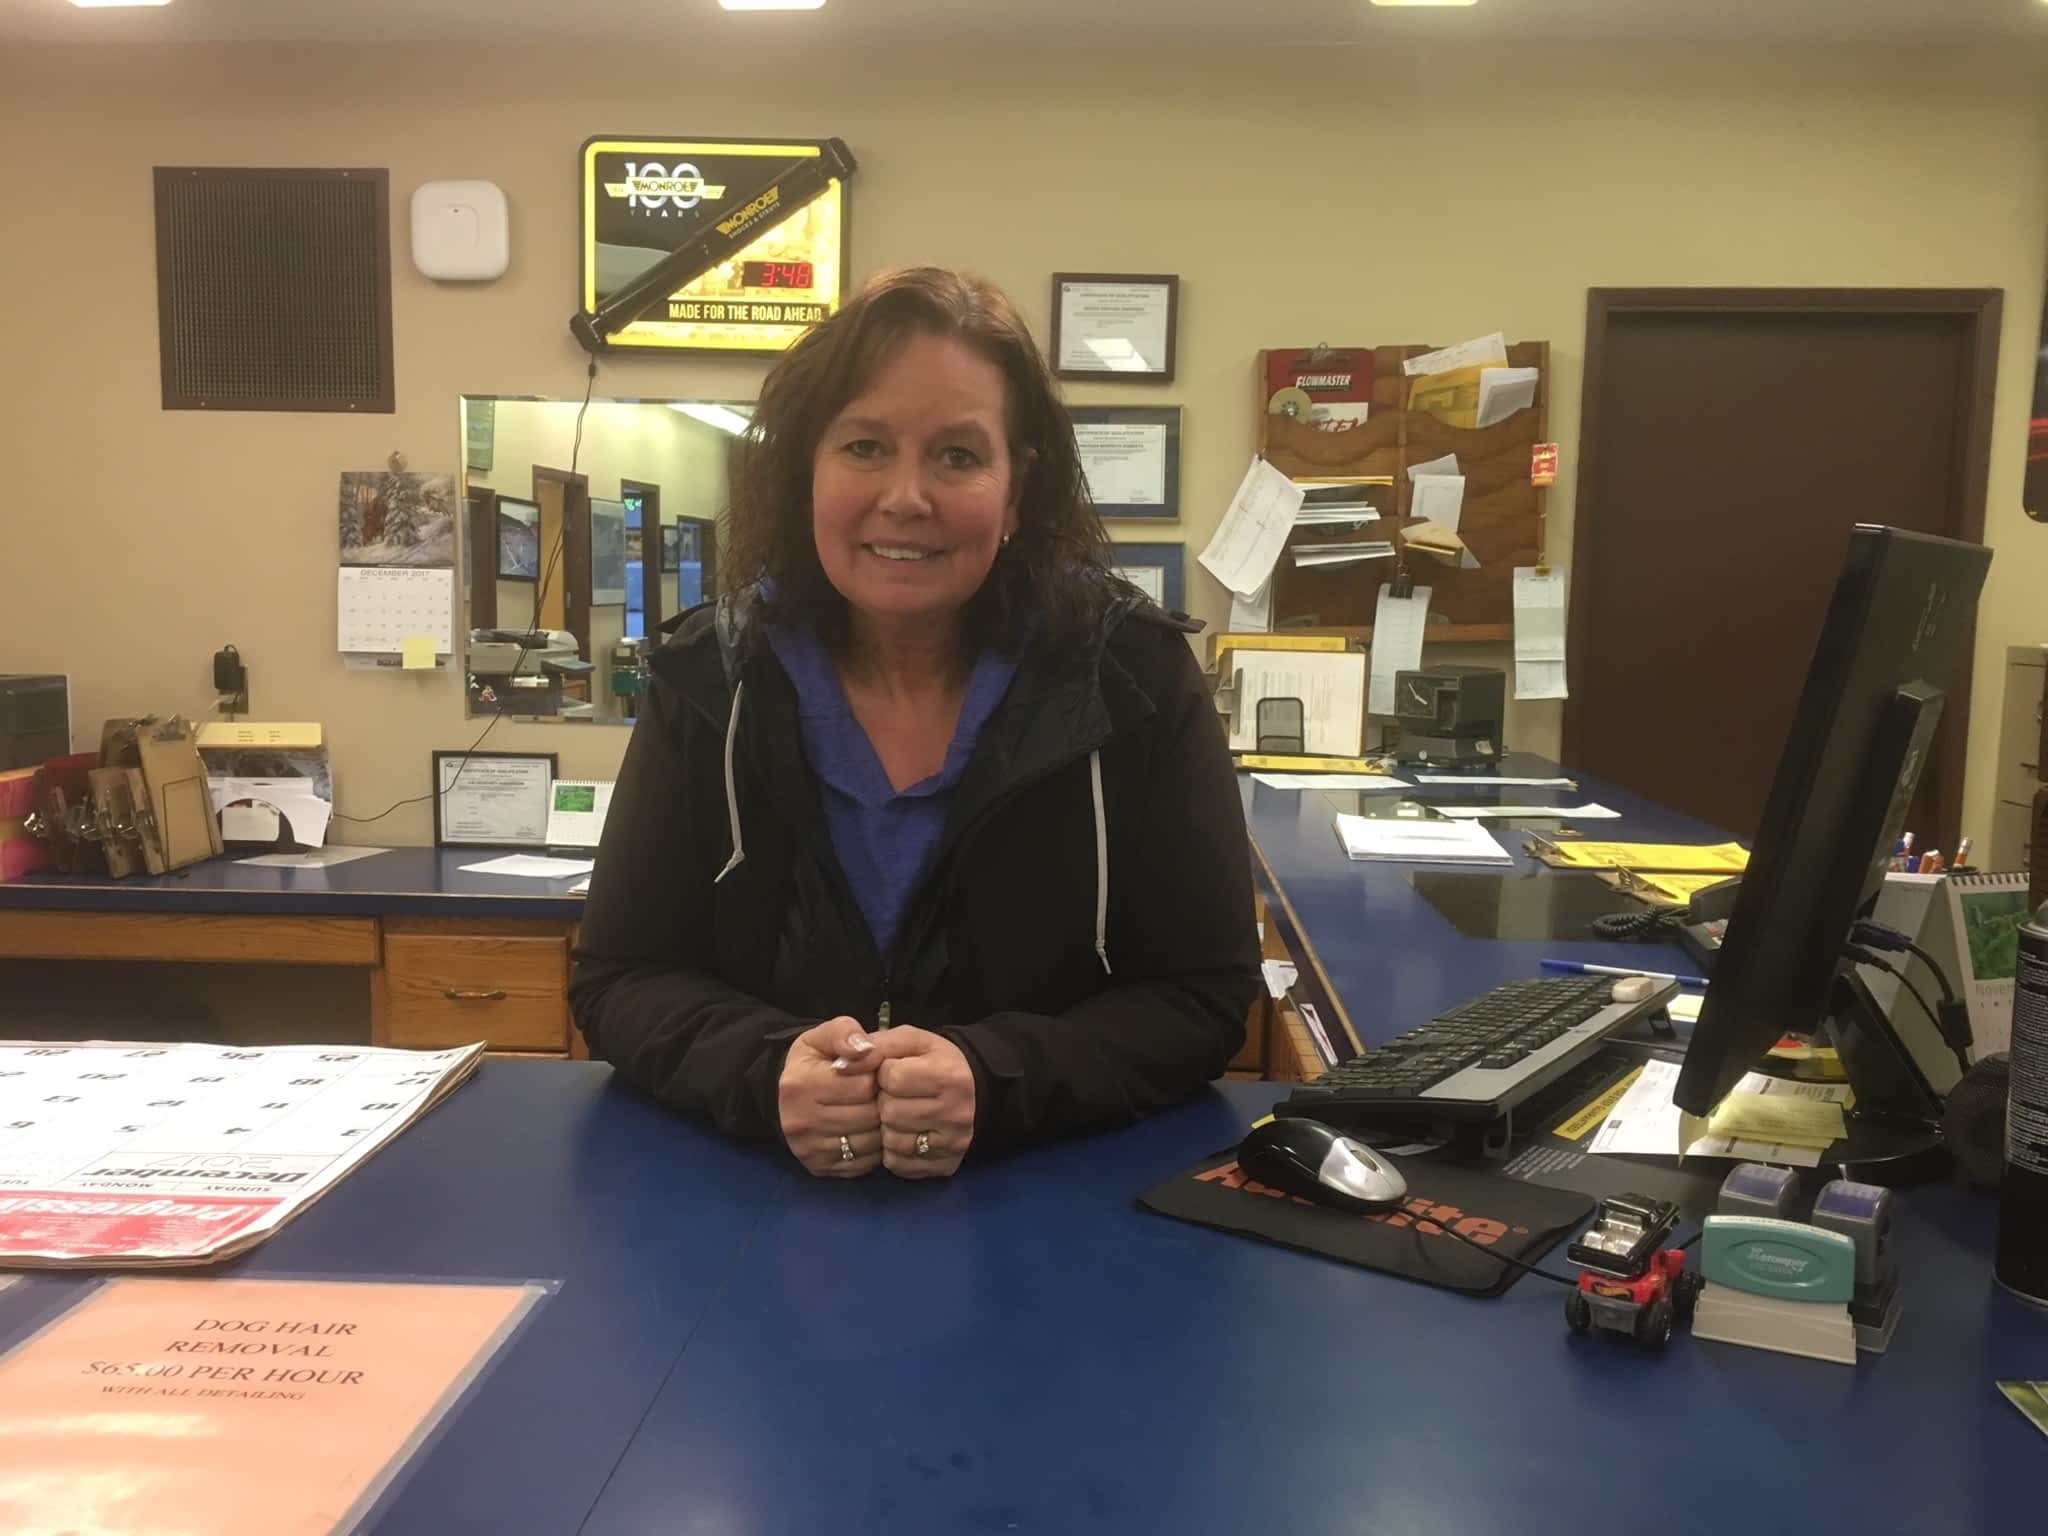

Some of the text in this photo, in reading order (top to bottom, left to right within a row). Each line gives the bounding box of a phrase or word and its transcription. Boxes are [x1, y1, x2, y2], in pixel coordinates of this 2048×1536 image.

[624, 162, 702, 209] 100
[639, 180, 692, 193] MONROE
[725, 190, 775, 230] MONROE
[761, 262, 811, 288] 3:48
[669, 303, 701, 319] MADE
[703, 304, 725, 320] FOR
[727, 305, 749, 320] THE
[751, 305, 782, 321] ROAD
[1296, 375, 1352, 389] FLOWMASTER
[314, 1054, 360, 1062] 25
[360, 1102, 400, 1111] 10
[82, 1168, 309, 1183] December
[79, 1181, 154, 1189] MONDAY
[203, 1184, 273, 1193] SUNDAY
[194, 1319, 358, 1336] DOG HAIR
[164, 1340, 333, 1358] REMOVAL
[81, 1360, 365, 1386] $65.00 PER HOUR
[101, 1385, 307, 1401] WITH ALL DETAILING
